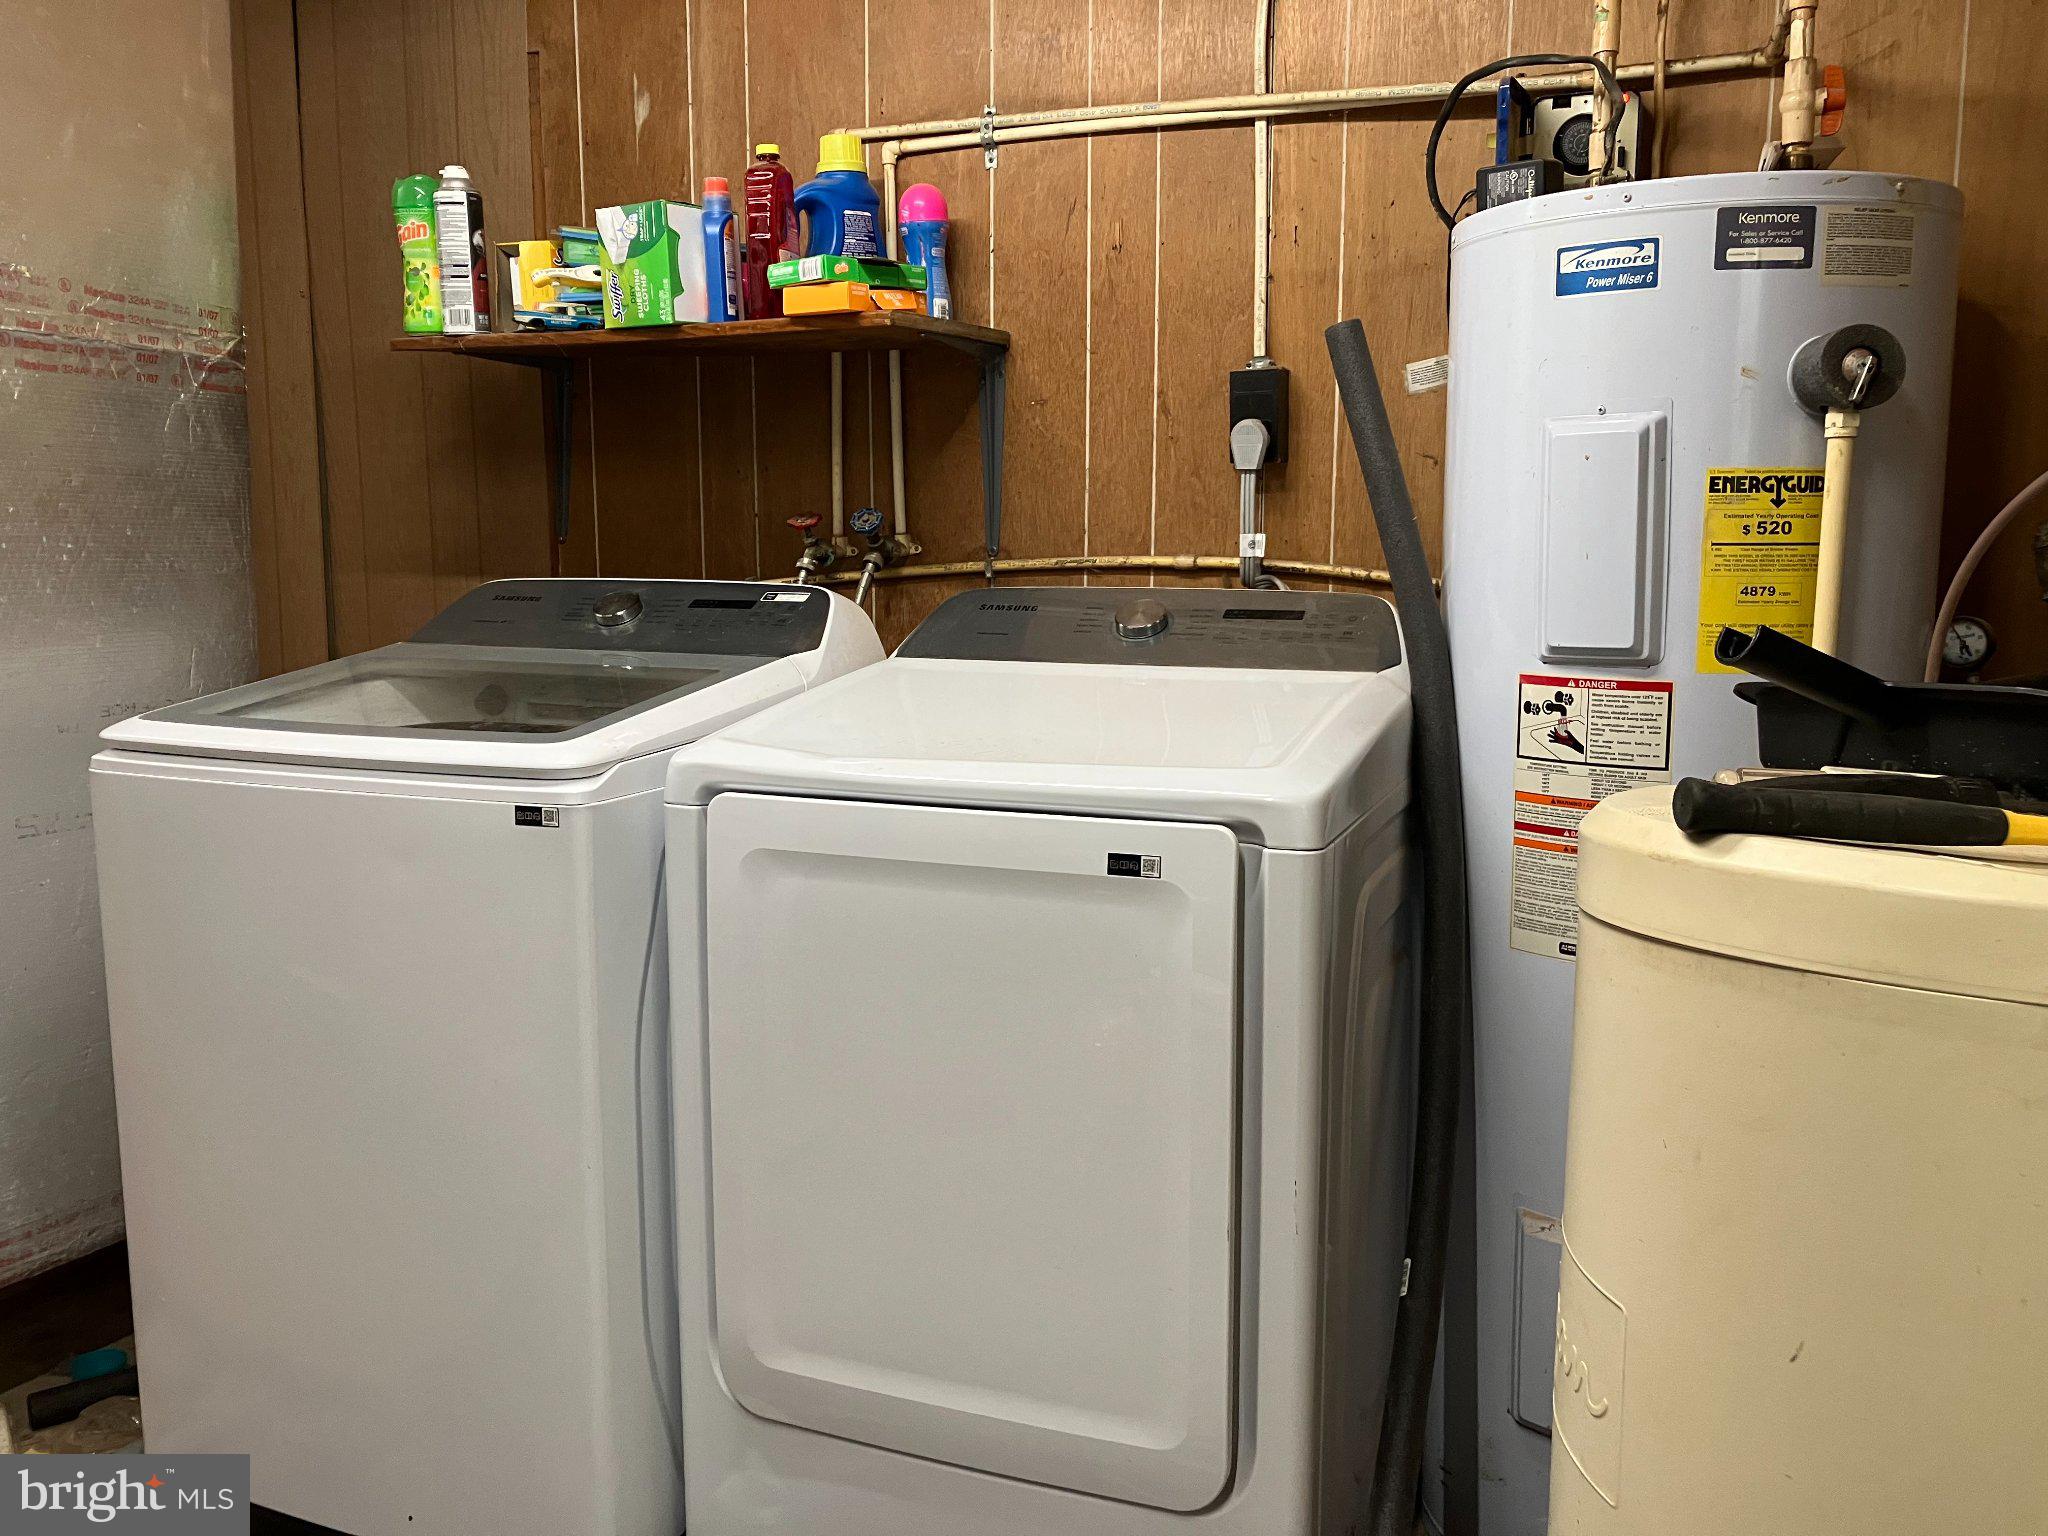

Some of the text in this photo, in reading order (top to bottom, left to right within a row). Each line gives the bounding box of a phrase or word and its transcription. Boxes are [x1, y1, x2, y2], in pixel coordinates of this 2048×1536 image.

[1738, 212, 1800, 224] Kenmore
[1574, 251, 1655, 271] Kenmore
[1586, 272, 1654, 289] Power Miser 6
[611, 270, 624, 323] Swiffer
[634, 268, 645, 319] SWEEPING
[1709, 474, 1824, 496] ENERGYGUID
[1742, 520, 1792, 536] $ 520
[492, 594, 542, 602] SAMSUNG
[1740, 586, 1776, 596] 4879
[978, 602, 1040, 612] SAMSUNG
[1578, 679, 1618, 690] DANGER
